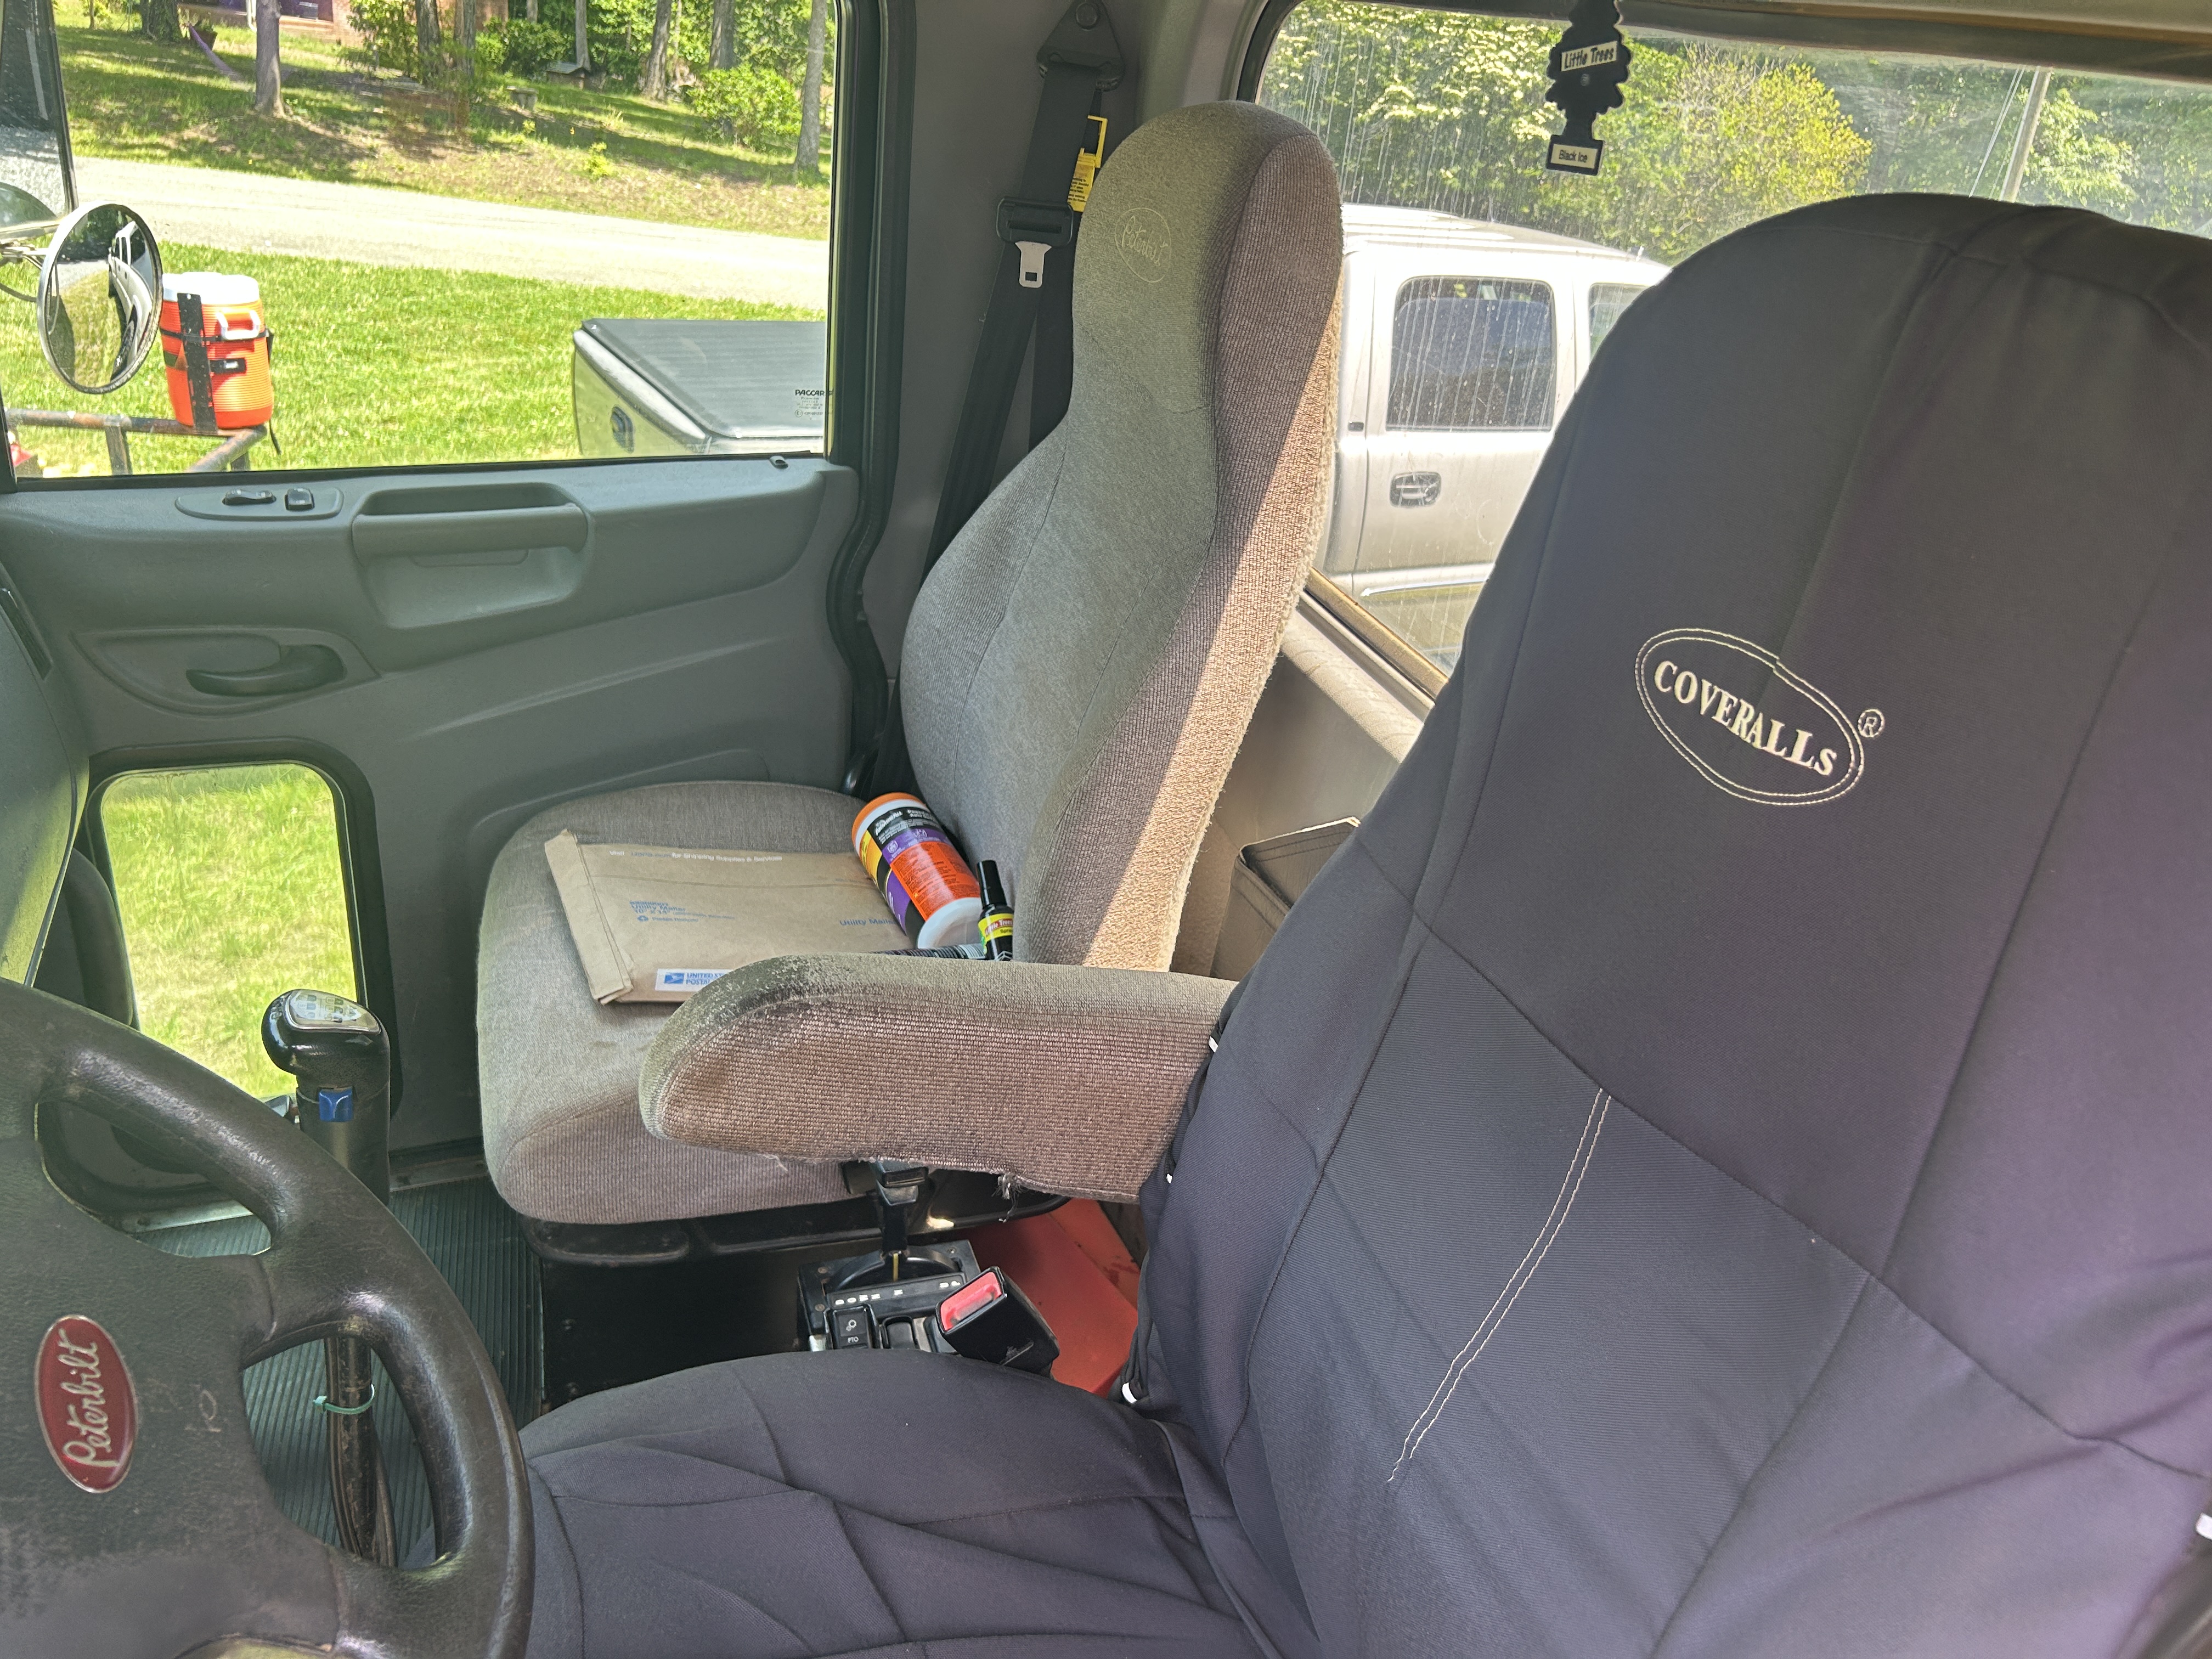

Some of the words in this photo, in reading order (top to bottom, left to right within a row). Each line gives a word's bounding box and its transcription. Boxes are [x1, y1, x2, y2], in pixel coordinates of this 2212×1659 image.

[1564, 49, 1588, 69] Little
[1590, 47, 1614, 63] Trees
[1559, 149, 1577, 161] Black
[1578, 152, 1588, 162] Ice
[1654, 661, 1837, 776] COVERALLS
[985, 921, 999, 936] Little
[58, 1327, 119, 1468] Peterbilt
